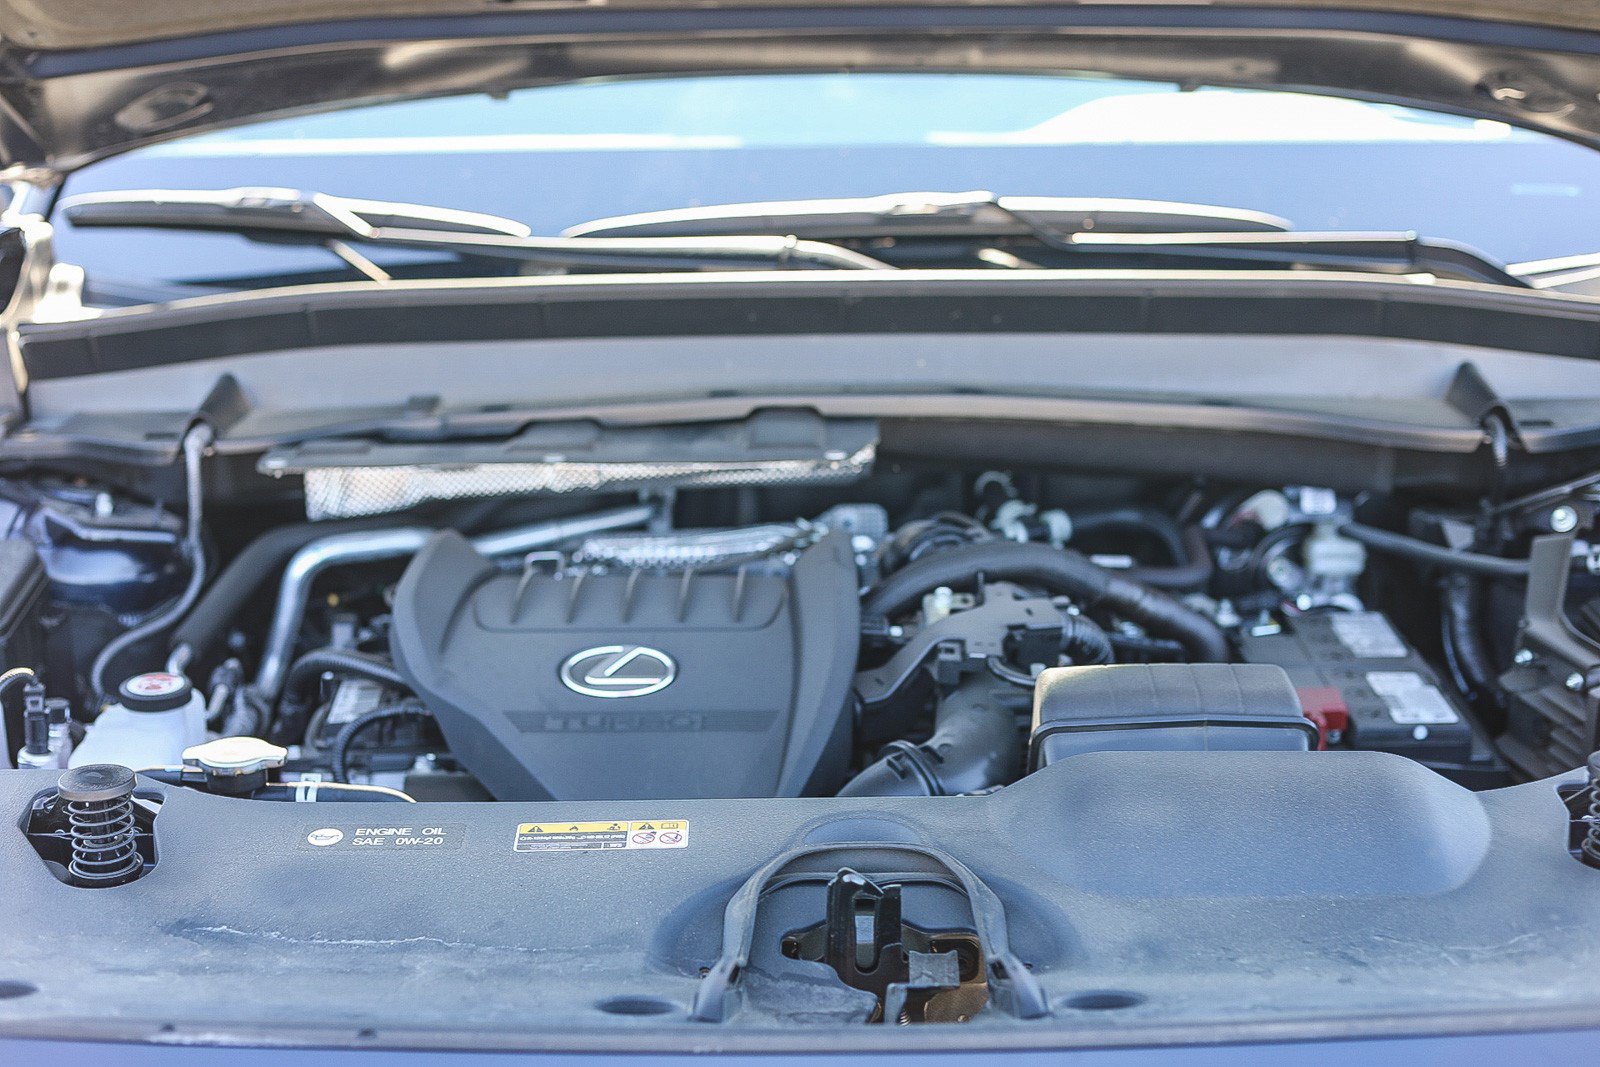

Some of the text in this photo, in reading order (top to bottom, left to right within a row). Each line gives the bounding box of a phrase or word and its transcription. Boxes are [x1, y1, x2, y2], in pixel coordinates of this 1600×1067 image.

[355, 827, 447, 836] ENGINE OIL
[352, 837, 444, 845] SAE 0W-20
